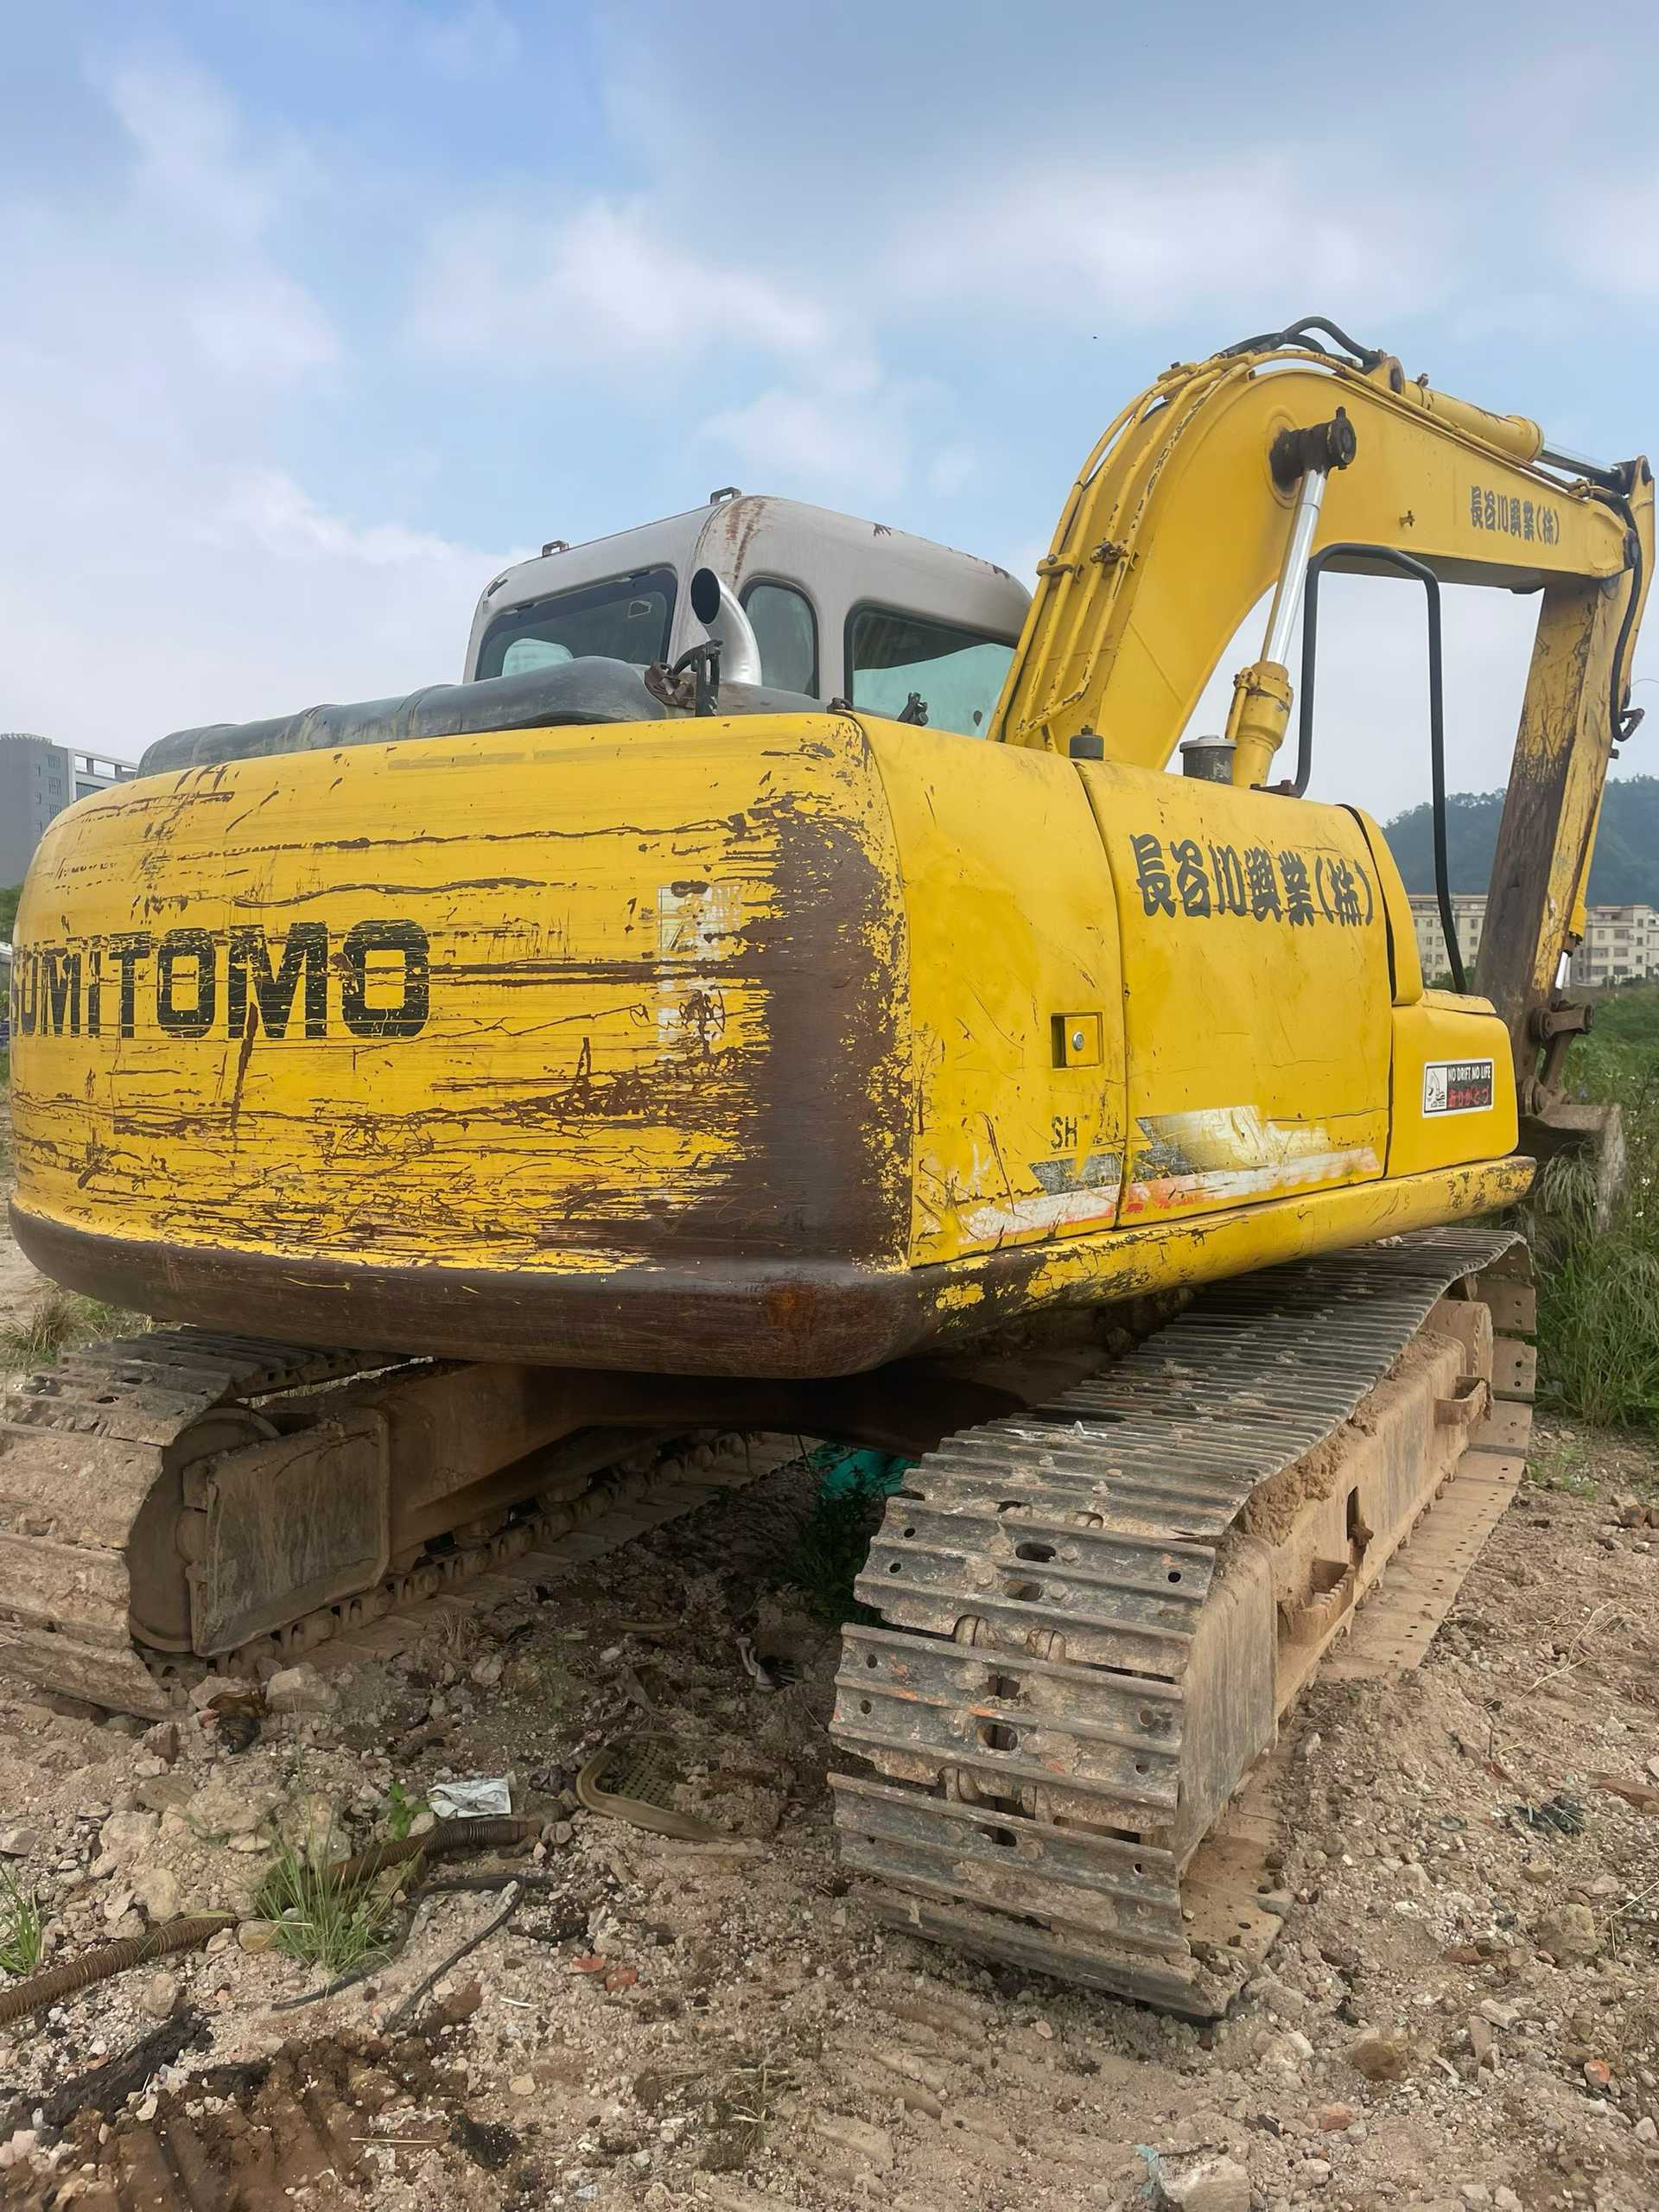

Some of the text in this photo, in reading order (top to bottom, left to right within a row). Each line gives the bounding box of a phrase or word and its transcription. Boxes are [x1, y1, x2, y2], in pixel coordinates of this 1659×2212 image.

[1447, 1065, 1491, 1082] NO DRIFT NO LIFE
